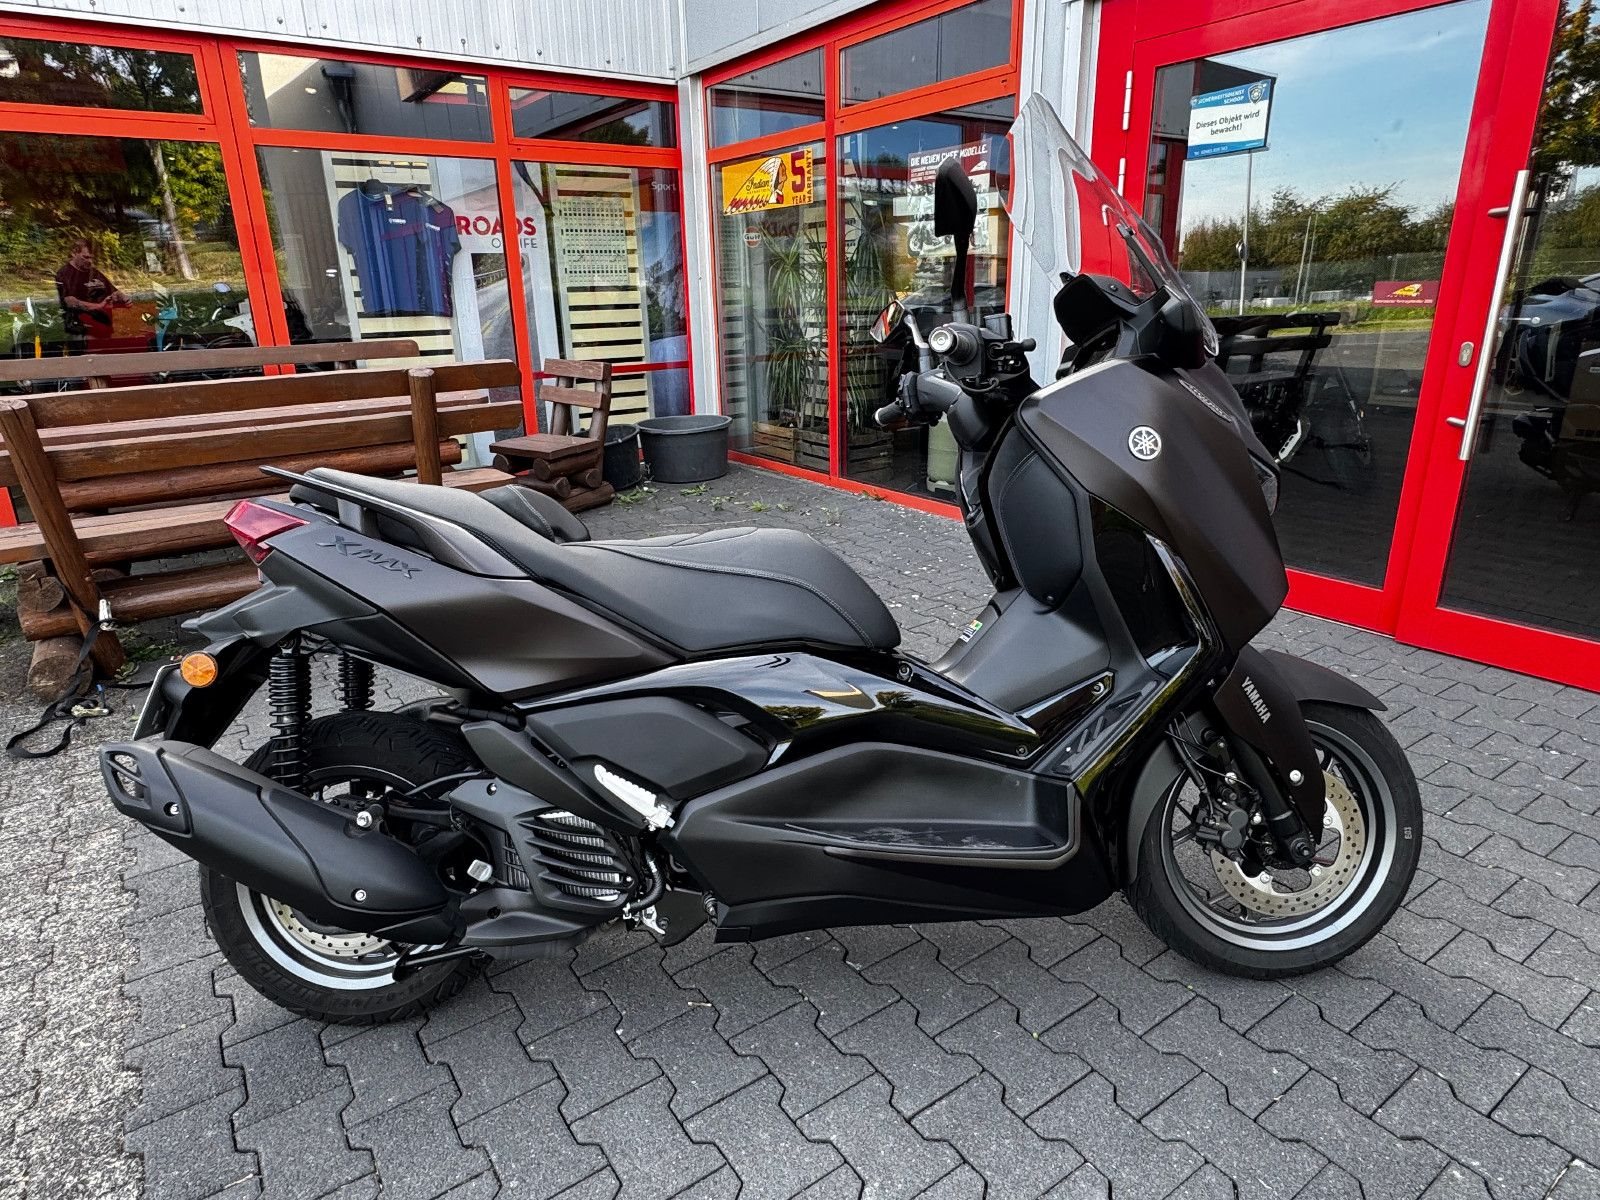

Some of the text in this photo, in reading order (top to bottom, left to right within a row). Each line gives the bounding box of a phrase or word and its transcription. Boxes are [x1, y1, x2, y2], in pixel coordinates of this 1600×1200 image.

[1196, 110, 1260, 130] Dieses Objekt wird
[1210, 123, 1243, 136] bewacht!
[911, 157, 920, 167] DIE
[921, 153, 941, 165] NEUEN
[790, 150, 806, 193] 5
[745, 177, 770, 191] Indian
[791, 194, 807, 205] YEAR
[519, 238, 538, 249] IFE
[1241, 676, 1271, 724] YAMAHA
